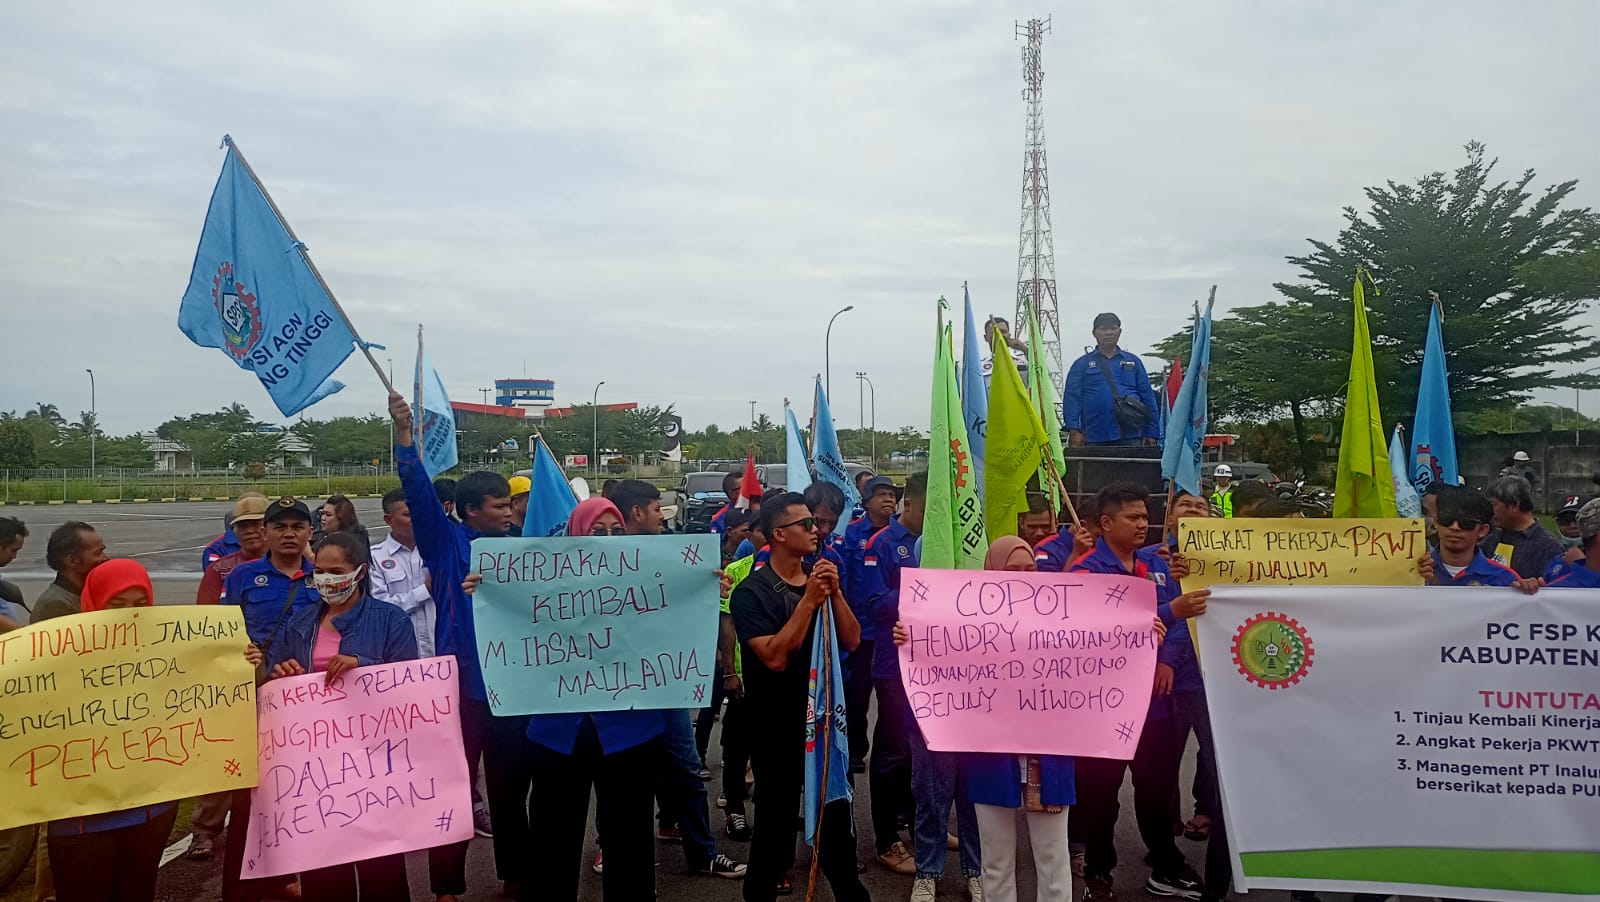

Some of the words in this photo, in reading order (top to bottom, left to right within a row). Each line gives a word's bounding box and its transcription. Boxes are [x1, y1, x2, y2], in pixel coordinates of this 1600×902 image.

[273, 313, 303, 352] AGN
[285, 310, 333, 364] TINGGI
[959, 497, 976, 527] EP
[1184, 529, 1254, 552] ANGKAT
[1344, 526, 1422, 560] PKWT
[479, 549, 640, 584] PEKERJAKAN
[956, 579, 1083, 620] COPOT
[151, 616, 239, 645] JANGAN
[909, 621, 1020, 662] HENDRY
[1028, 624, 1155, 651] MARDIANSYAH
[1486, 622, 1521, 641] PC
[1529, 623, 1578, 642] FSP
[1032, 656, 1126, 680] SARTONO
[1440, 646, 1599, 667] KABUPATEN
[0, 671, 57, 698] OLIM
[81, 657, 186, 688] KEPADA
[283, 677, 349, 706] KERAS
[355, 660, 452, 697] PELAKU
[558, 648, 709, 700] MAULANA
[165, 681, 254, 720] SERIKAT
[911, 687, 997, 719] BENNY
[1478, 690, 1600, 710] TUNTUTA
[1394, 711, 1406, 723] 1.
[1413, 711, 1463, 727] Tinjau
[1469, 713, 1536, 728] Kembali
[1542, 714, 1600, 730] Kinerja
[9, 717, 235, 786] PEKERJA
[1396, 734, 1410, 746] 2.
[1416, 735, 1475, 749] Angkat
[1481, 737, 1542, 752] Pekerja
[1547, 738, 1600, 753] PKWT
[266, 737, 415, 804] DALAM
[1397, 759, 1411, 771] 3.
[1416, 760, 1524, 776] Management
[1529, 764, 1550, 776] PT
[1555, 764, 1600, 779] Inalu
[1416, 778, 1502, 794] berserikat
[1507, 782, 1566, 796] kepada
[1572, 783, 1600, 797] PU
